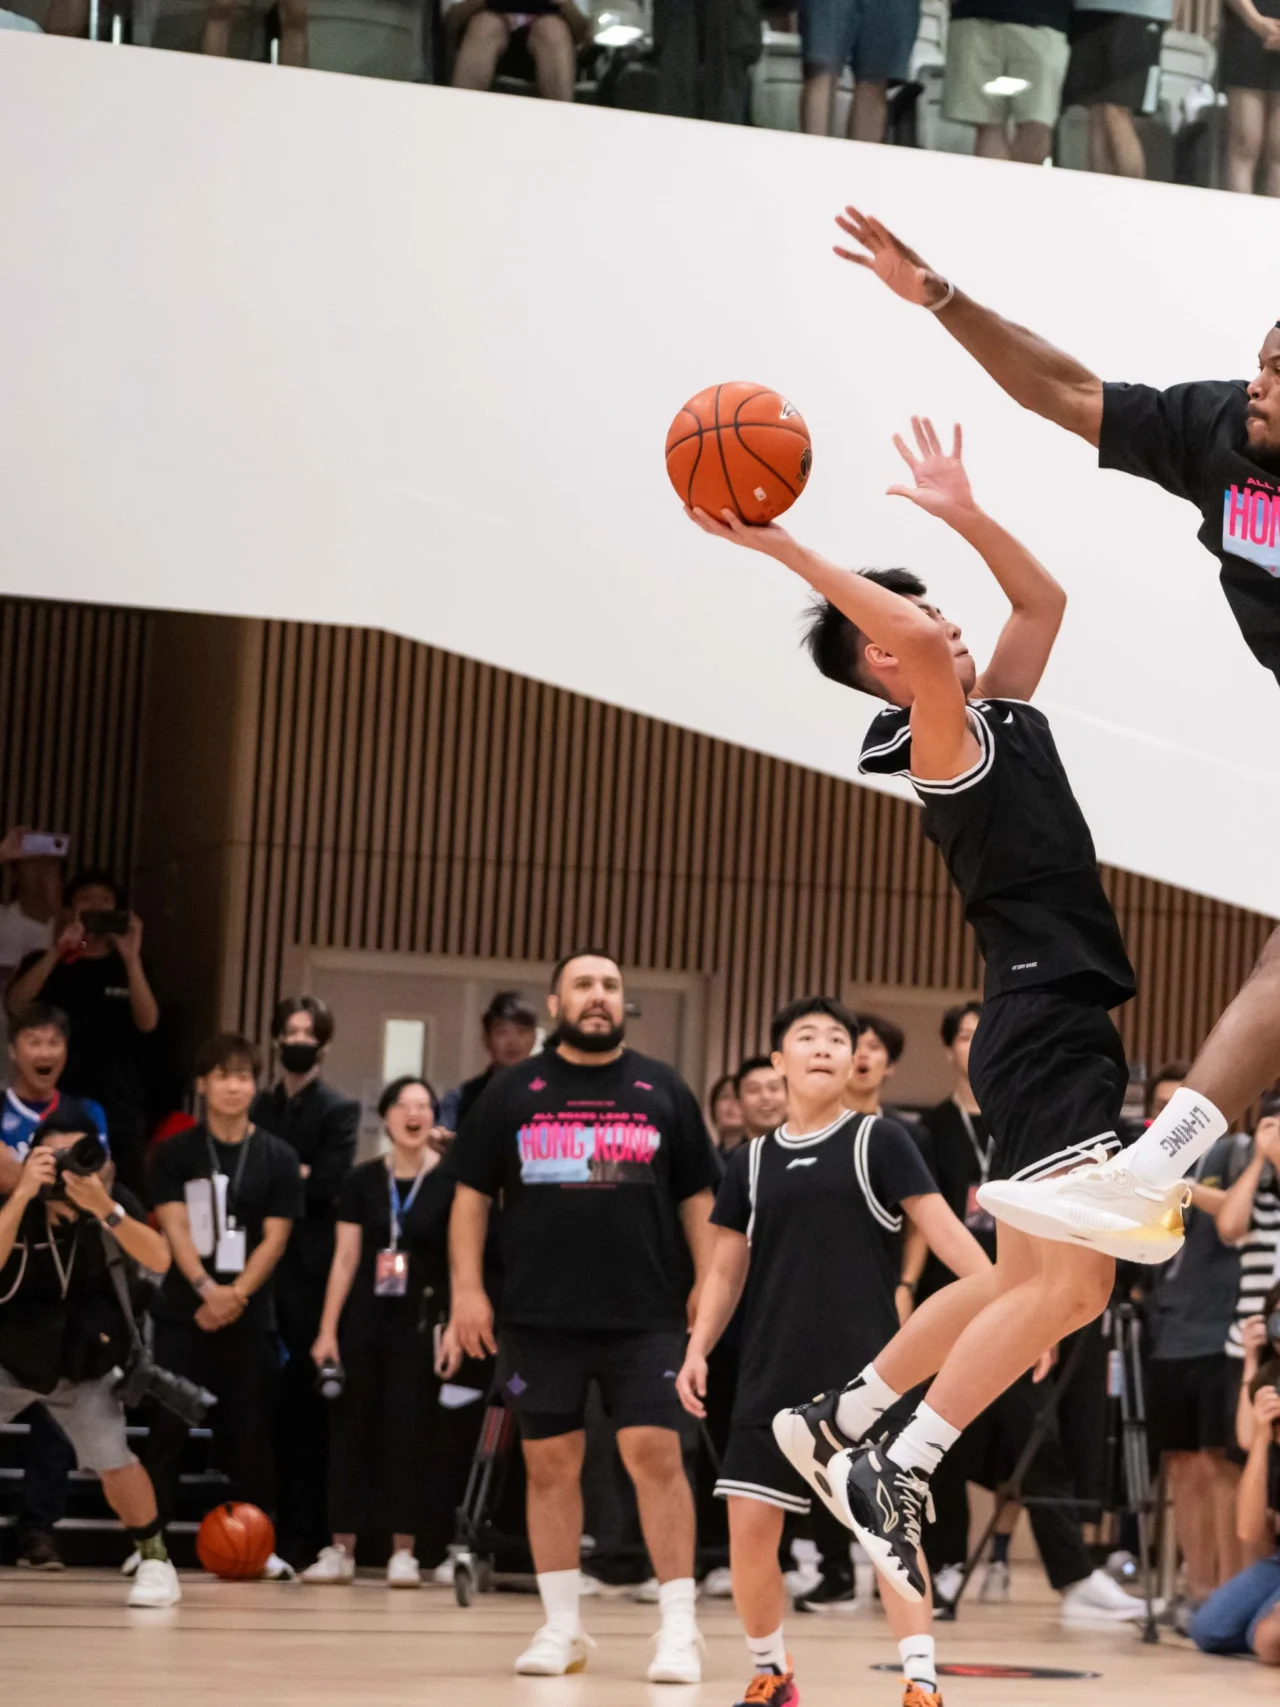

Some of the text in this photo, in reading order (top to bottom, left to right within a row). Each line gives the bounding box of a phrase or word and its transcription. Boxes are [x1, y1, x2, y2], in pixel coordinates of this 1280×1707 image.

[1246, 477, 1274, 490] ALL
[519, 1121, 659, 1164] HONG KONG
